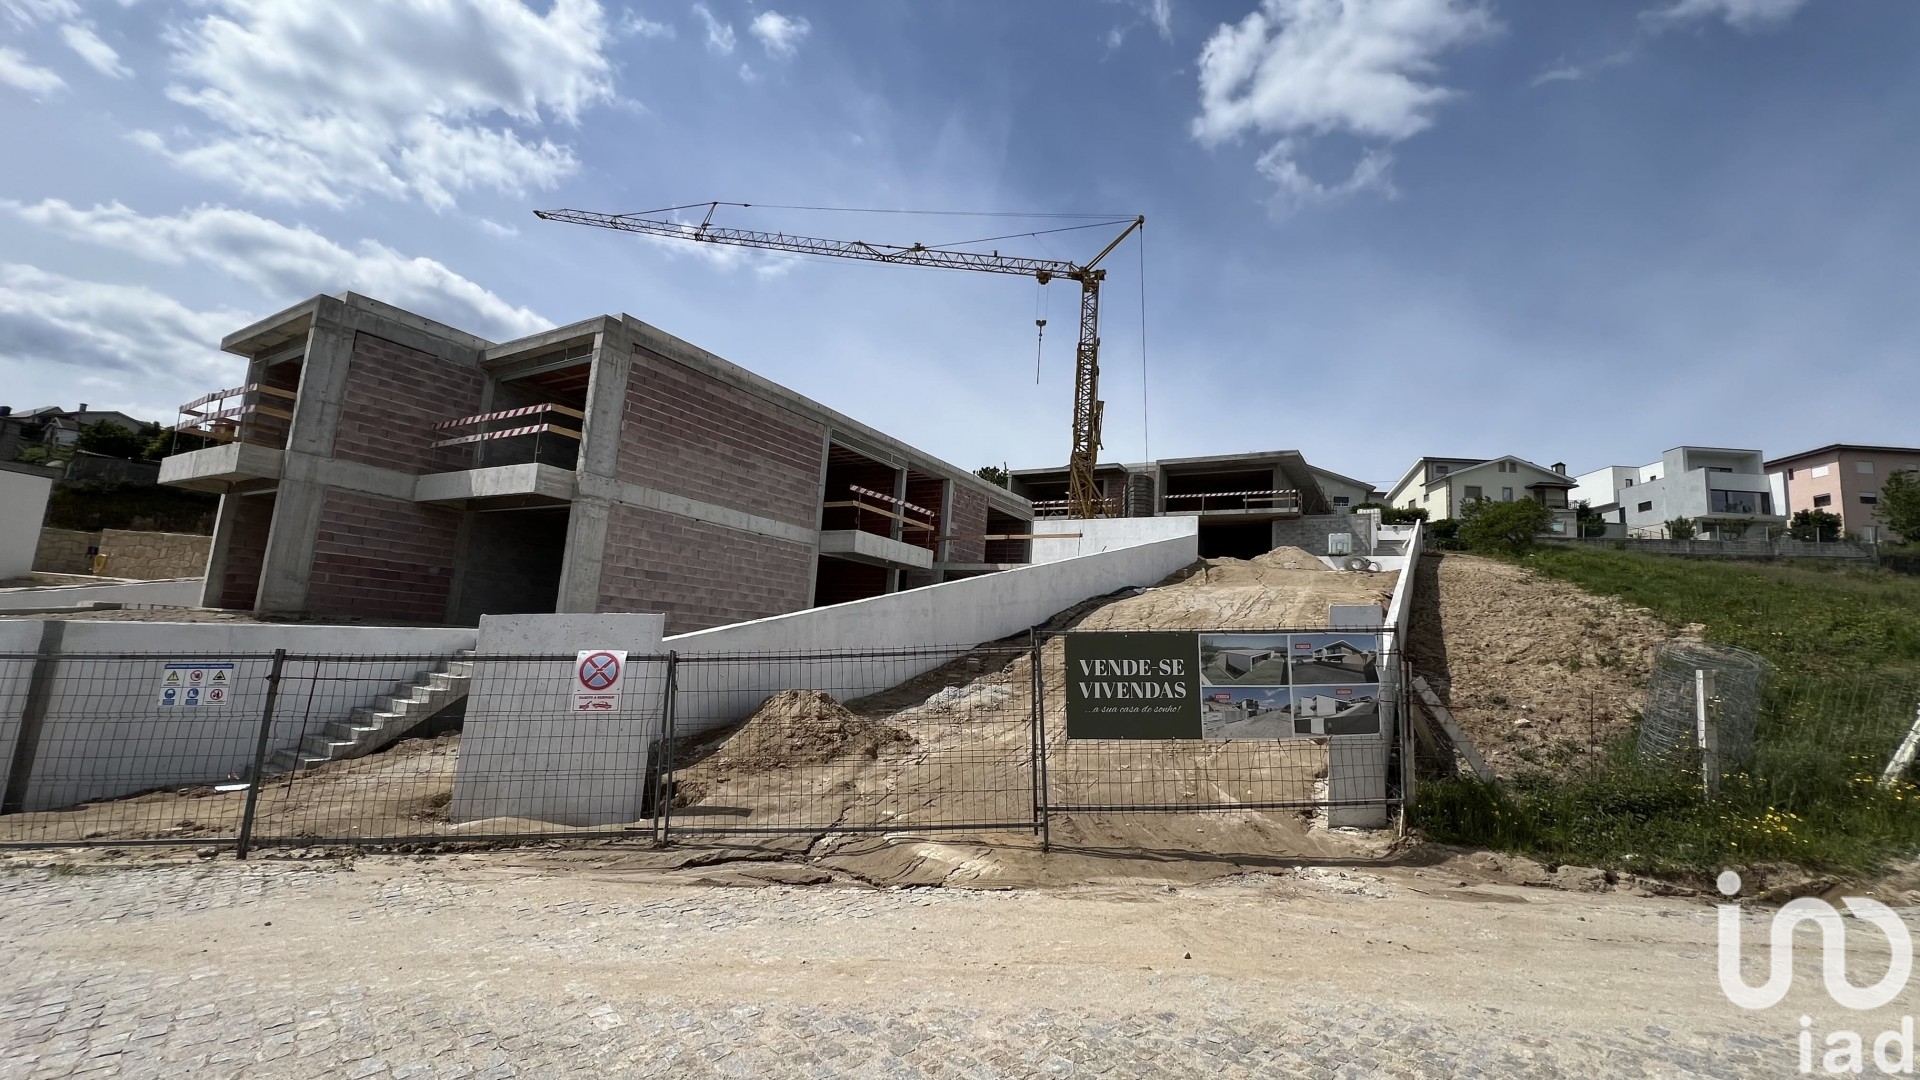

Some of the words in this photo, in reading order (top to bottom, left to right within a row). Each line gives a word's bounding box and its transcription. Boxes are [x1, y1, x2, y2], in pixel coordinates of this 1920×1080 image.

[1079, 659, 1185, 676] VENDE-SE
[1079, 681, 1187, 699] VIVENDAS
[1141, 704, 1153, 713] de
[1153, 704, 1182, 713] sonho!
